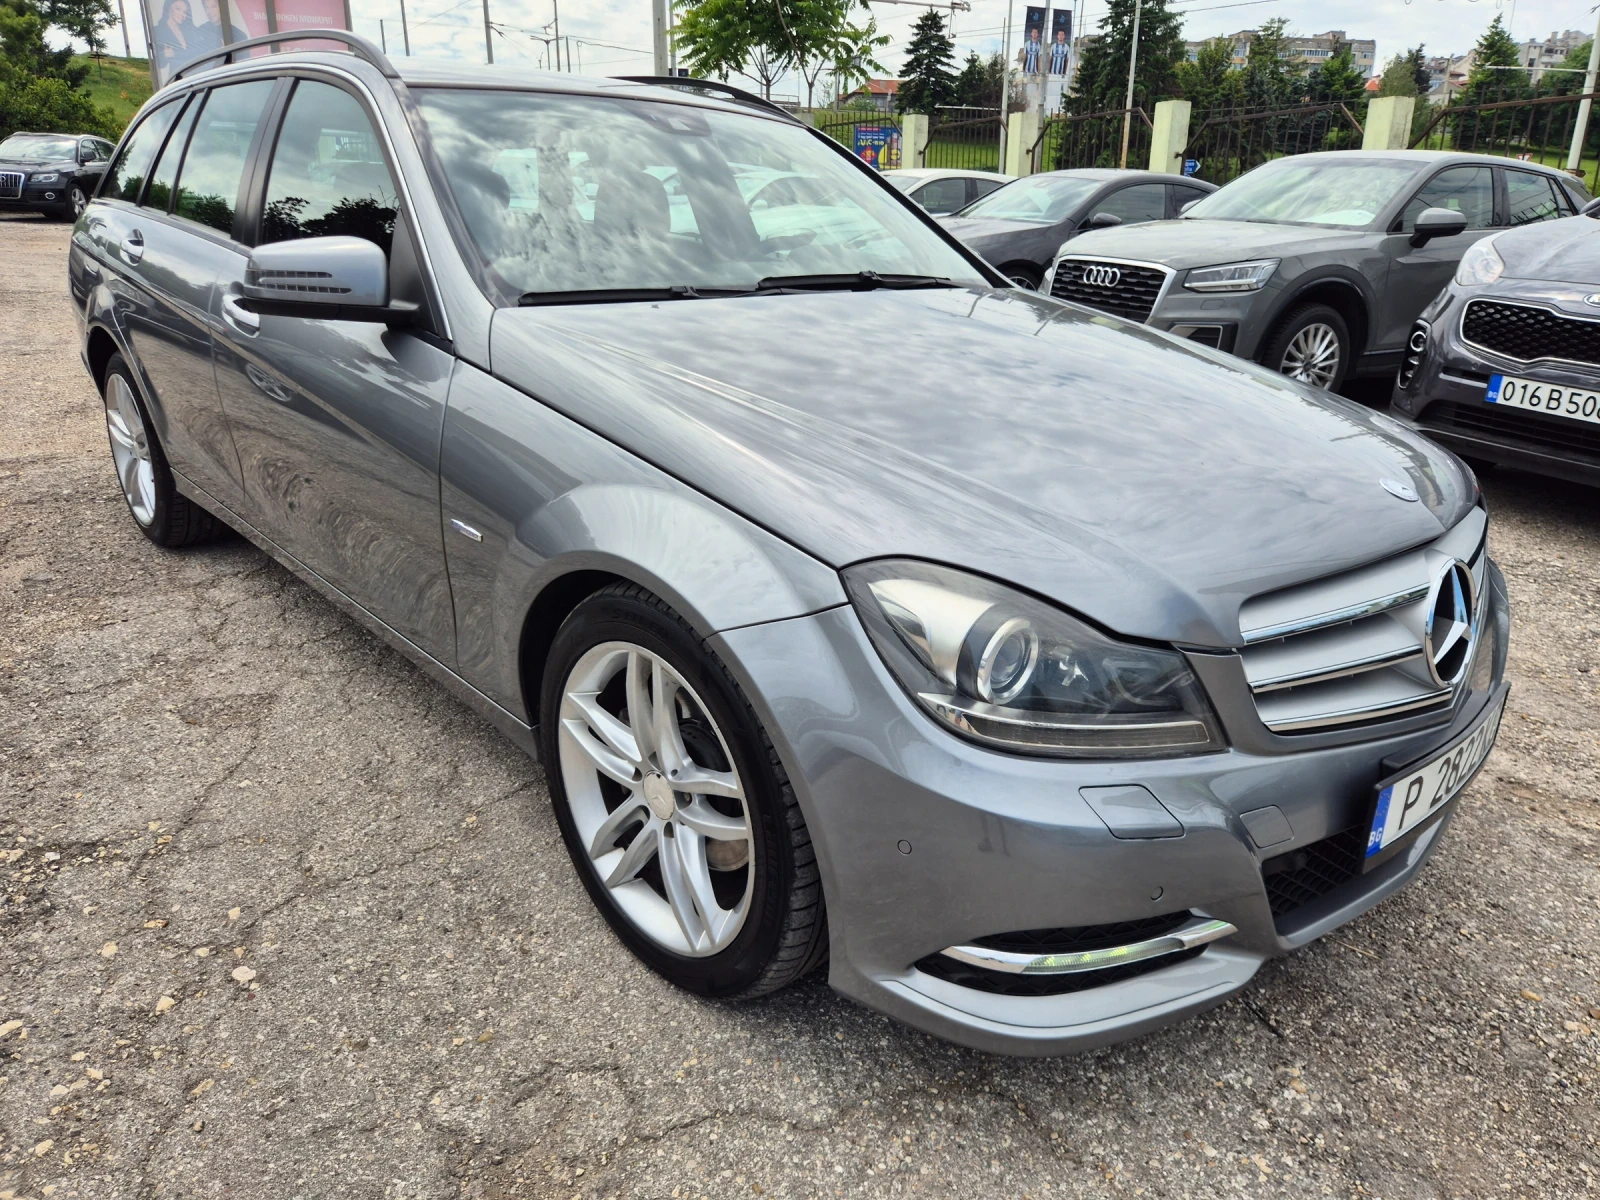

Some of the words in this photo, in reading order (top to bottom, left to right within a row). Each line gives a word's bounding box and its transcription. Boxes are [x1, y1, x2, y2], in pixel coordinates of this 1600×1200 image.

[1488, 390, 1498, 399] BG
[1398, 775, 1424, 830] P
[1430, 725, 1485, 808] 2822
[1368, 828, 1383, 846] BG
